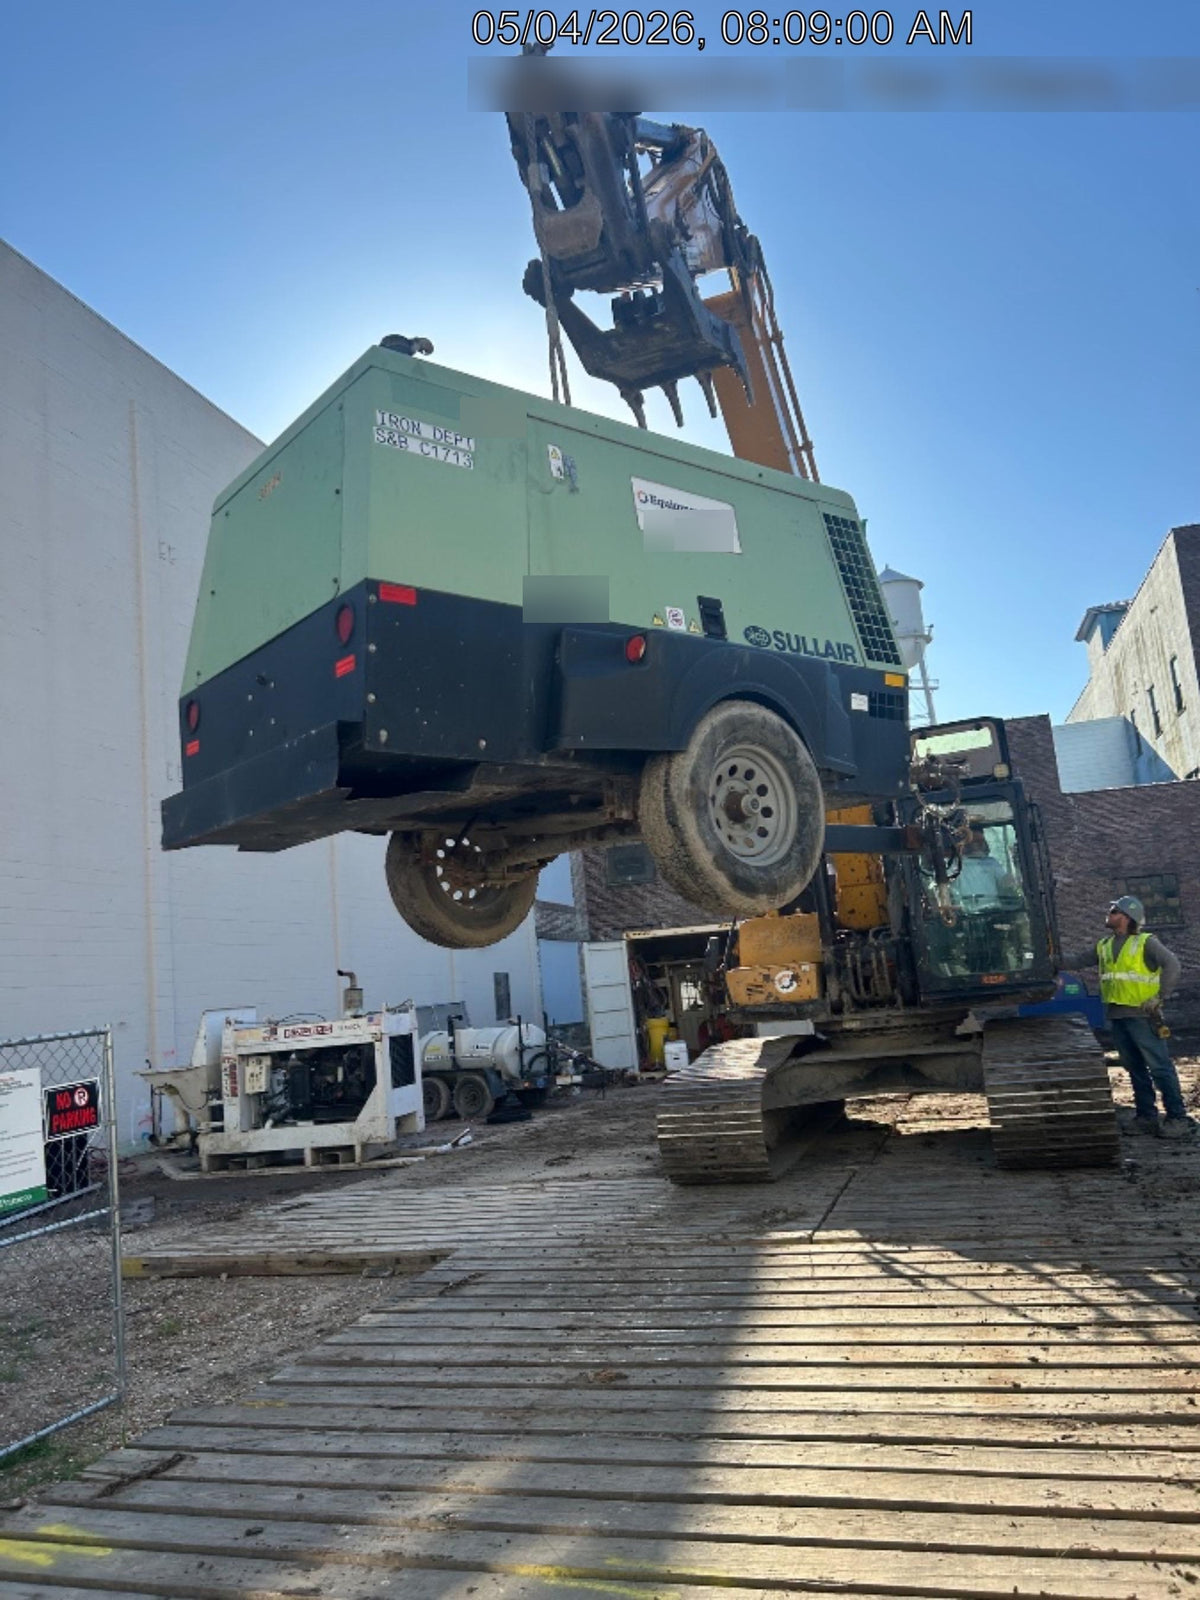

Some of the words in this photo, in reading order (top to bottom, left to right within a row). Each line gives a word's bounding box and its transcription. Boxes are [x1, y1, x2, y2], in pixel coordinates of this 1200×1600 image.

[379, 411, 421, 435] IRON
[376, 428, 408, 450] S&B
[421, 442, 472, 468] C1713
[773, 630, 858, 664] SULLAIR
[56, 1092, 71, 1109] NO
[53, 1109, 95, 1131] PARKING
